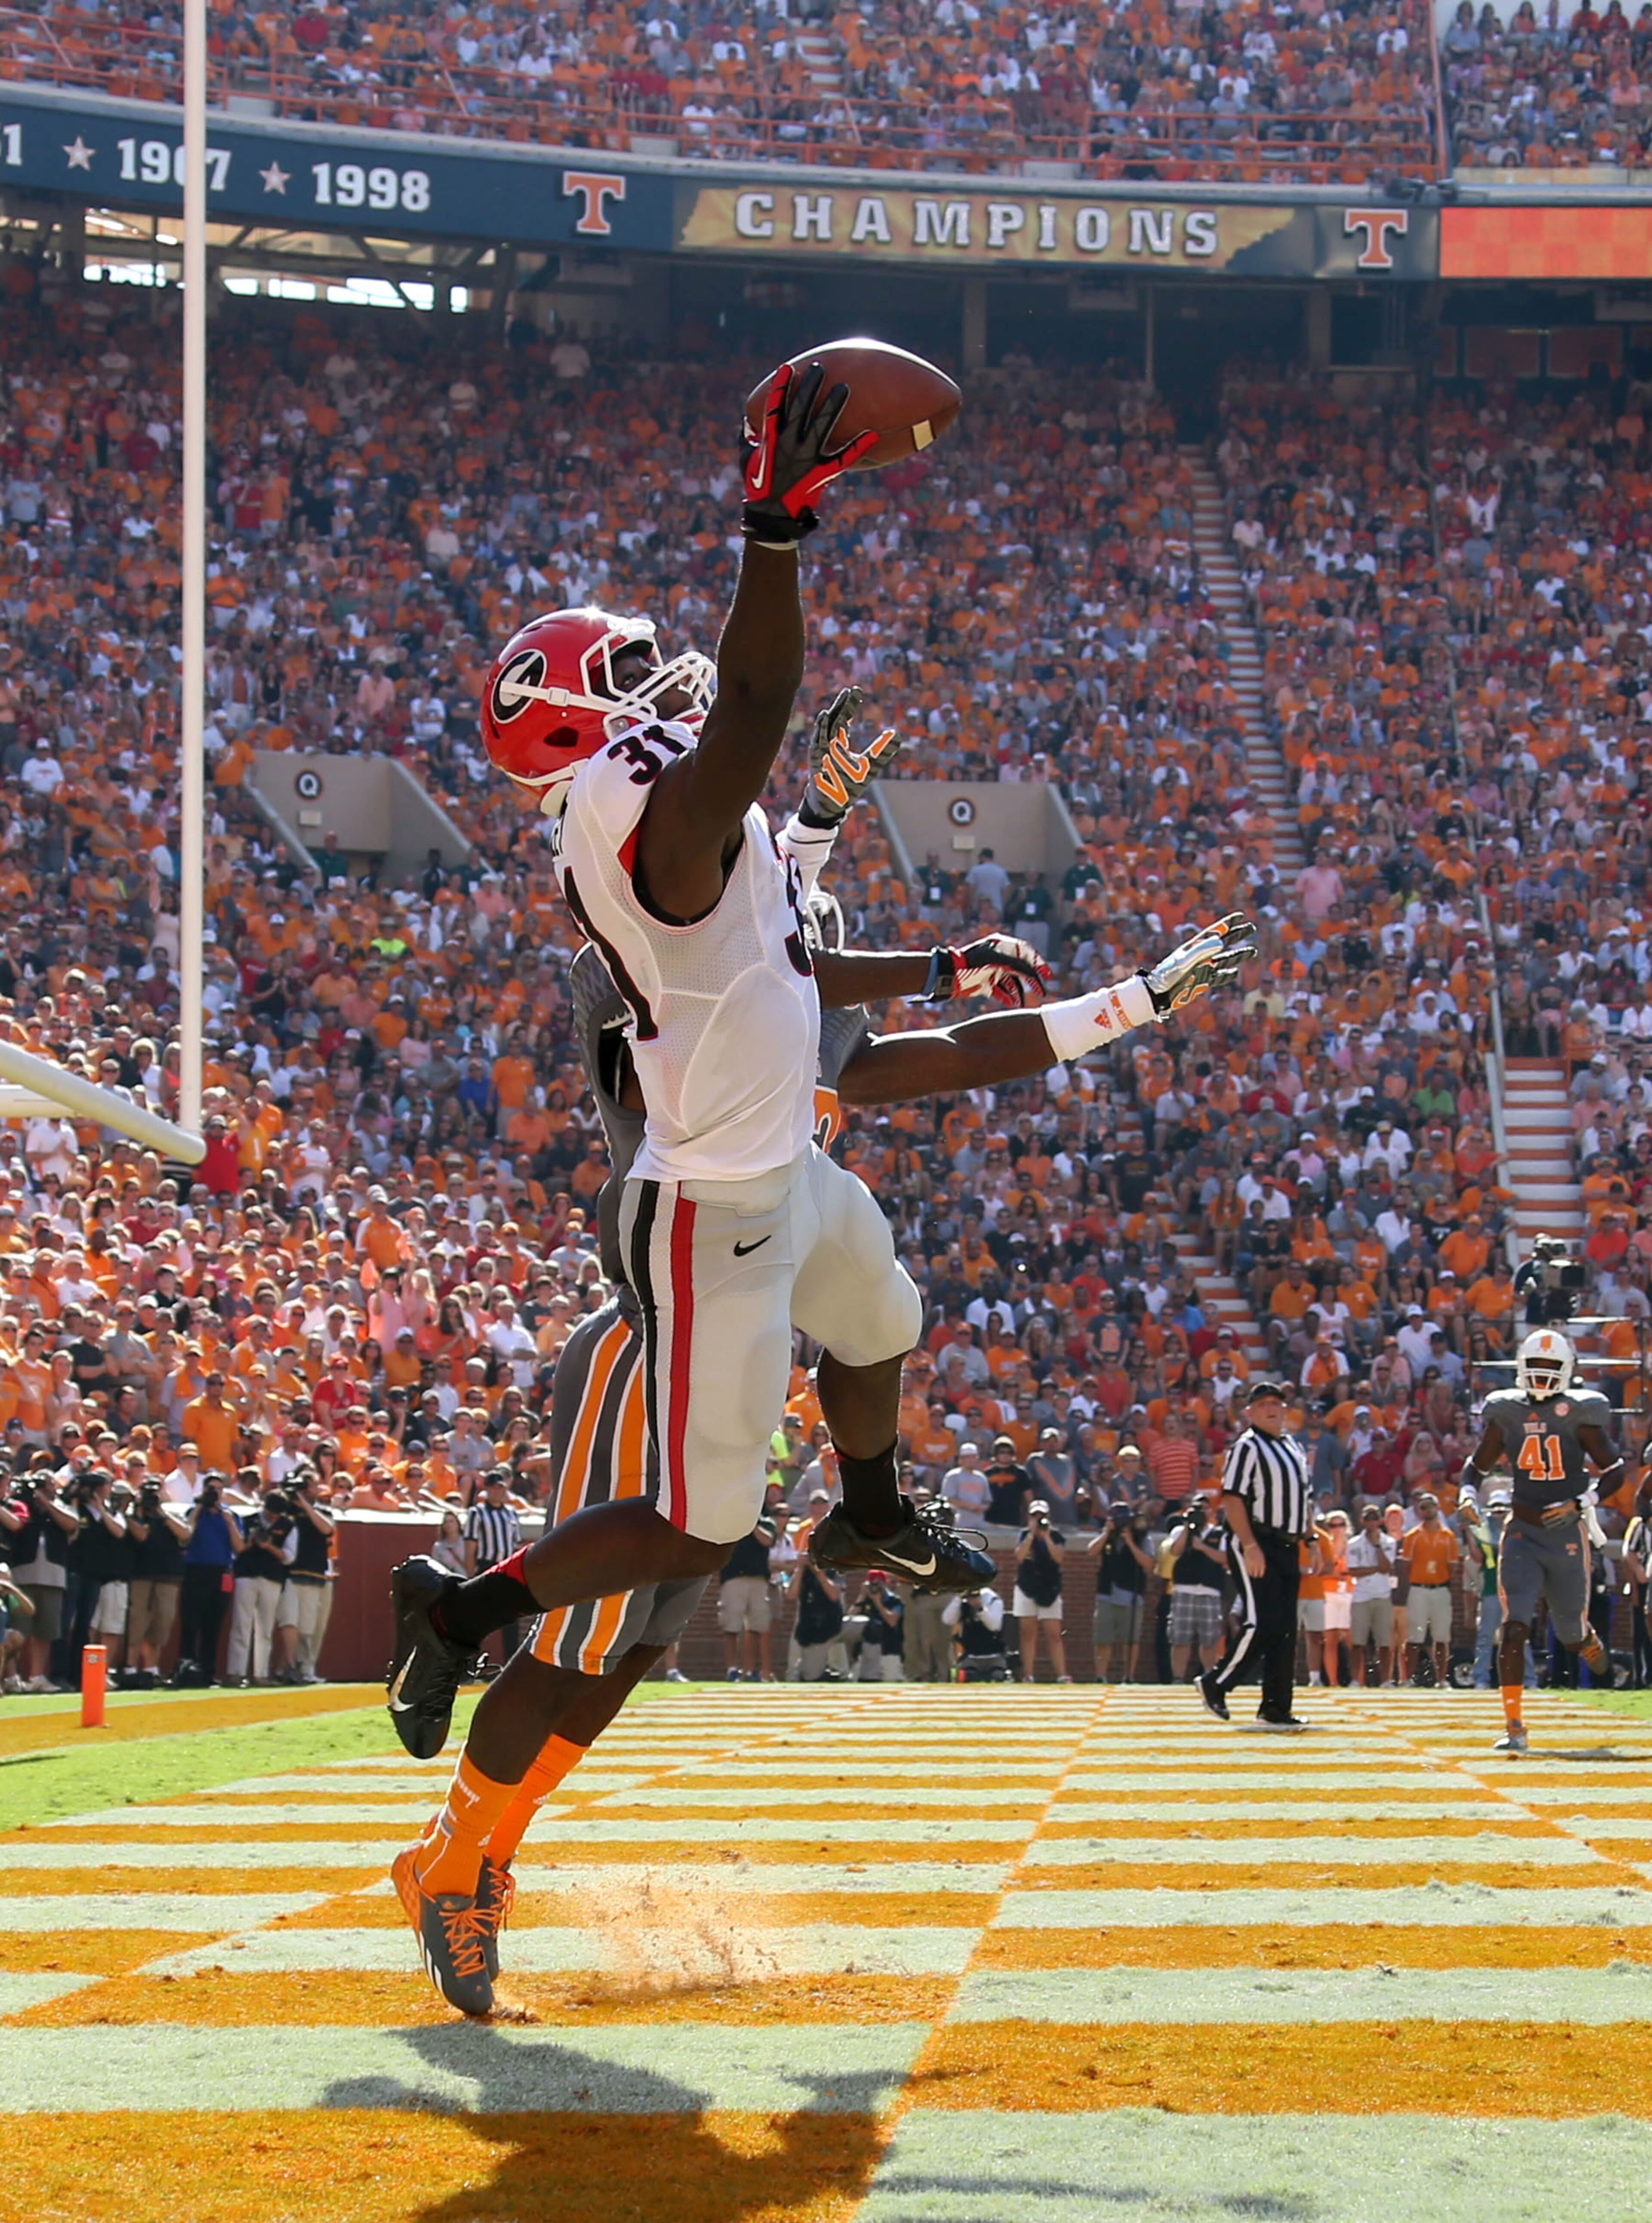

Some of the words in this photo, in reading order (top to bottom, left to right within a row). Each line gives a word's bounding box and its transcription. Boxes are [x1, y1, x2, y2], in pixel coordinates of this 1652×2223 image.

[0, 123, 22, 166] 1
[312, 163, 431, 212] 1998
[563, 170, 626, 235] T
[736, 192, 1219, 256] CHAMPIONS
[1344, 209, 1409, 268] T
[299, 773, 317, 795] Q
[607, 724, 690, 785] 31
[952, 801, 971, 823] Q
[1517, 1434, 1566, 1480] 41
